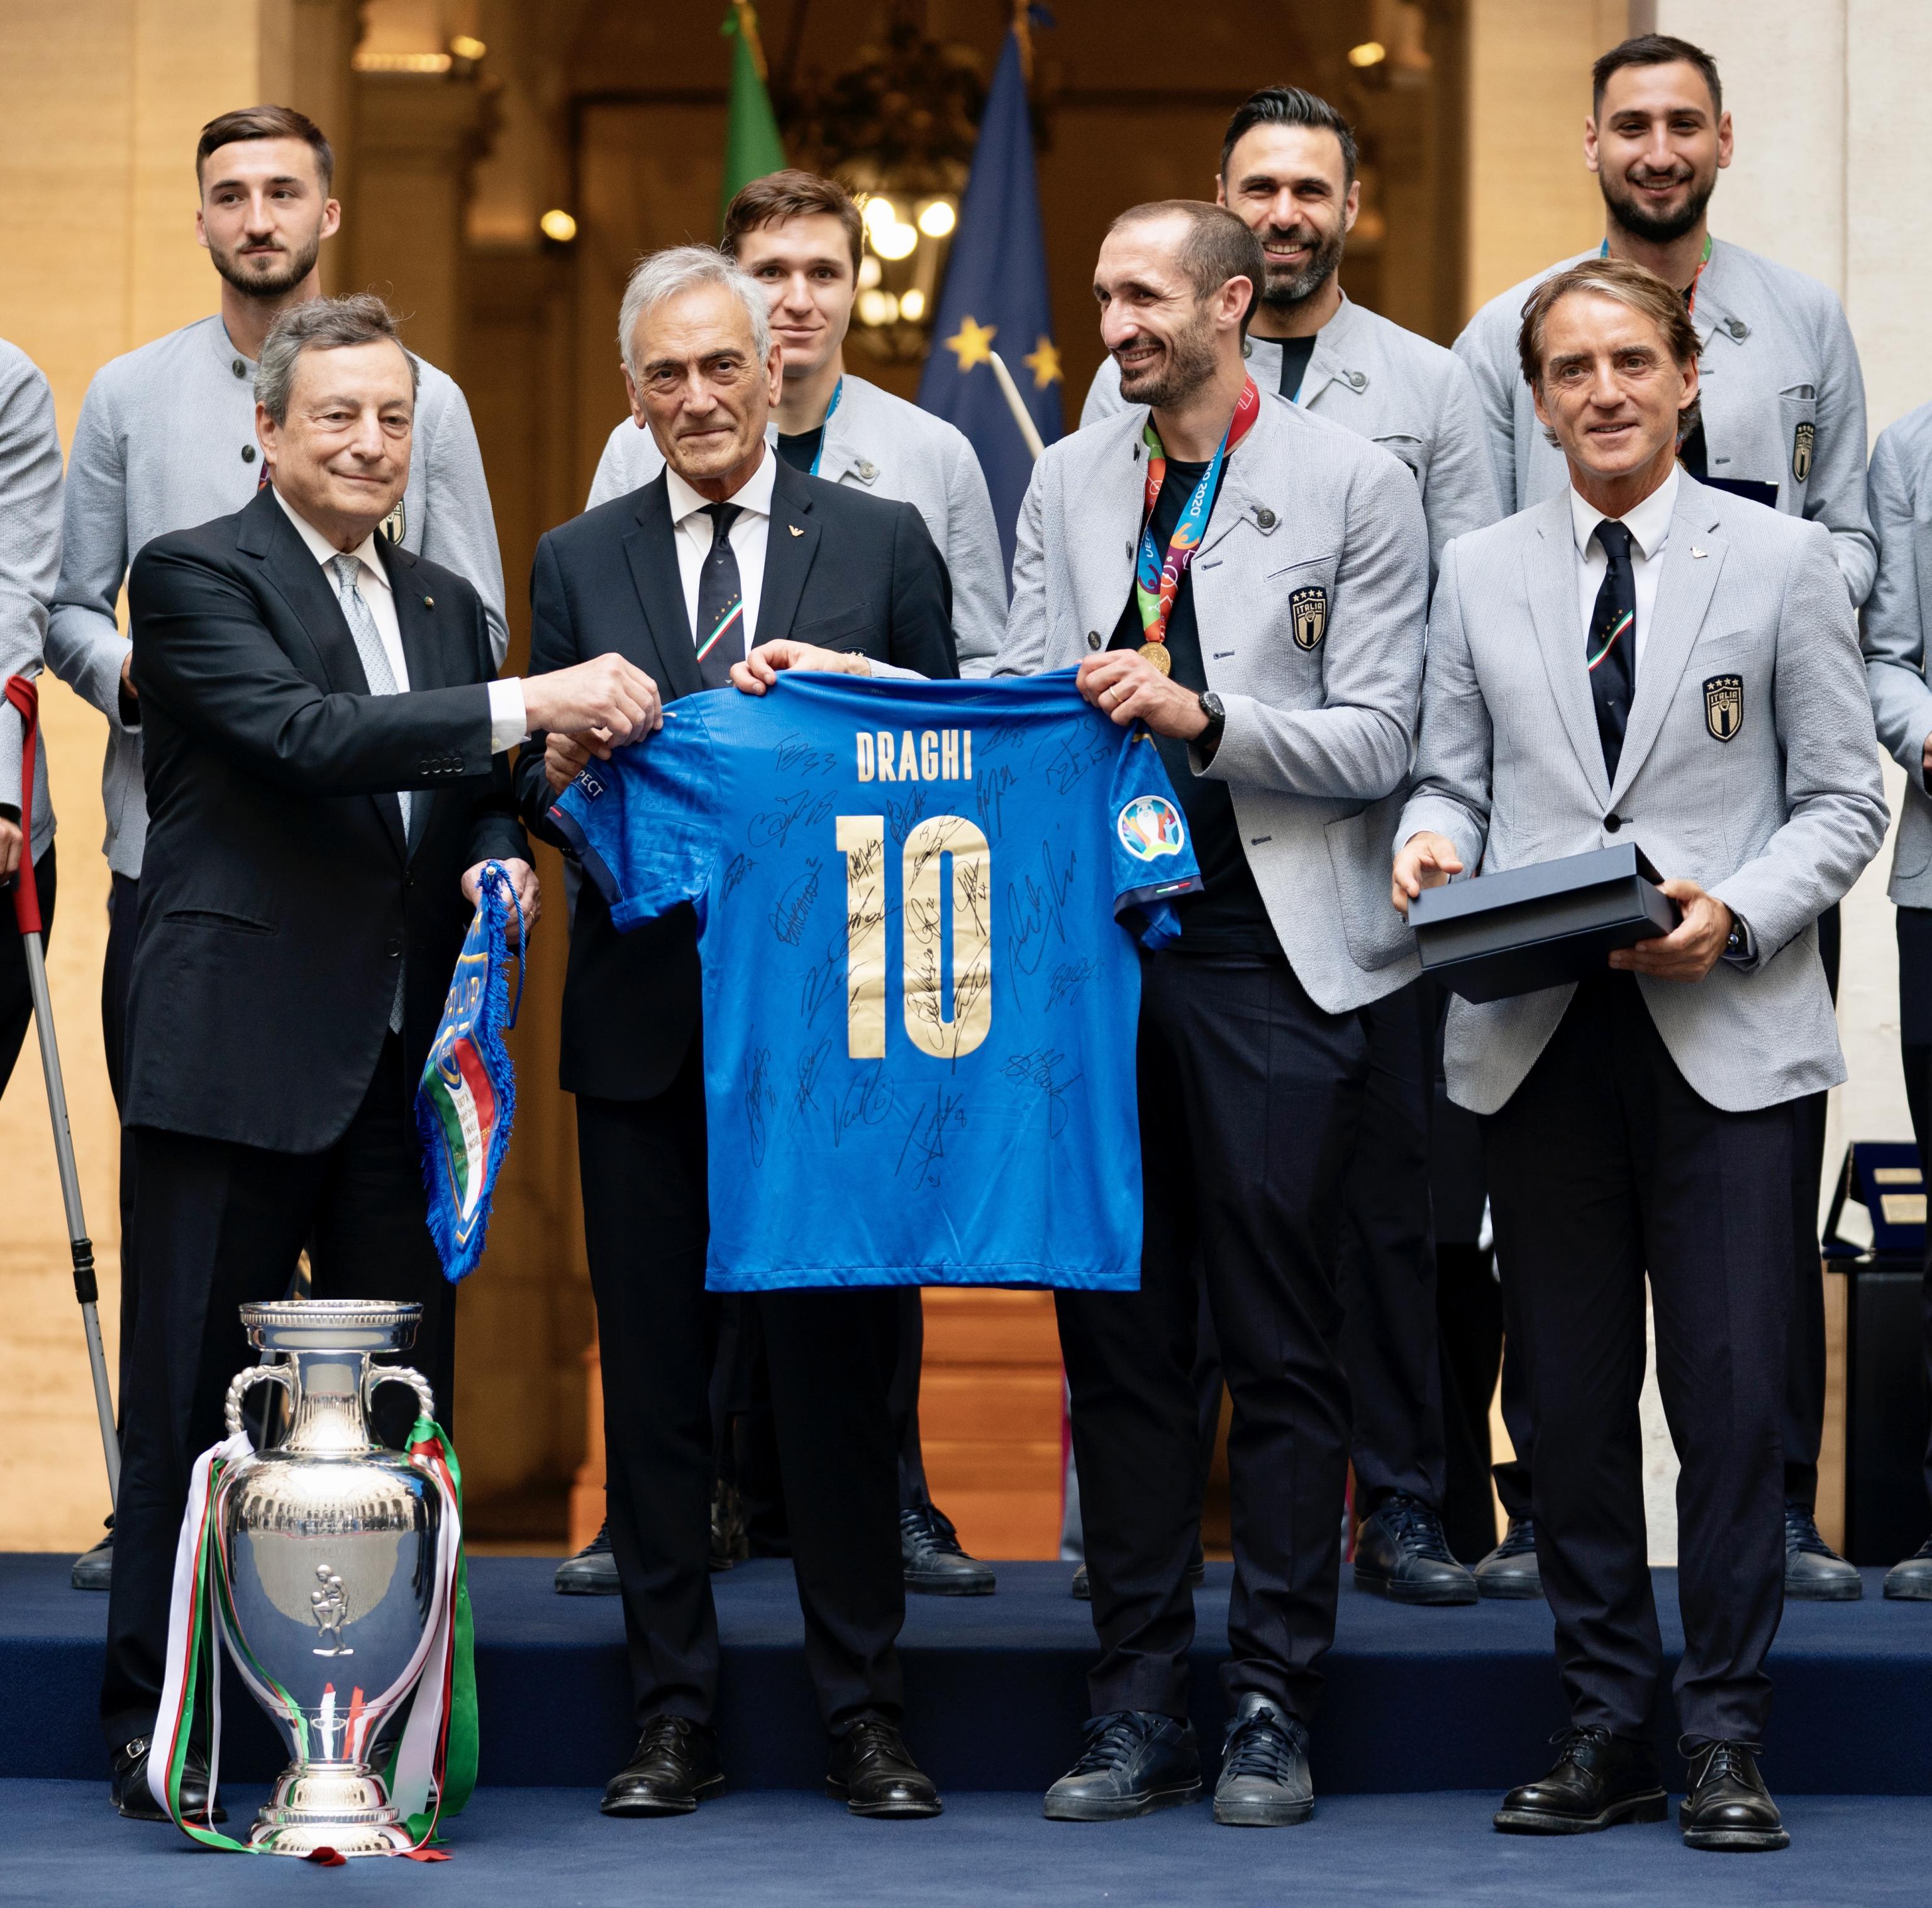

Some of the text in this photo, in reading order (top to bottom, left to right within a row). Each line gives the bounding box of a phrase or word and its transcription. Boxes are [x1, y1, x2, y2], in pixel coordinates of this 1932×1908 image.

[1190, 482, 1208, 516] 2020
[1296, 602, 1323, 615] ITALIA
[1711, 691, 1738, 703] ITALIA
[856, 729, 972, 782] DRAGHI
[575, 770, 604, 797] PECT
[835, 815, 991, 1059] 10
